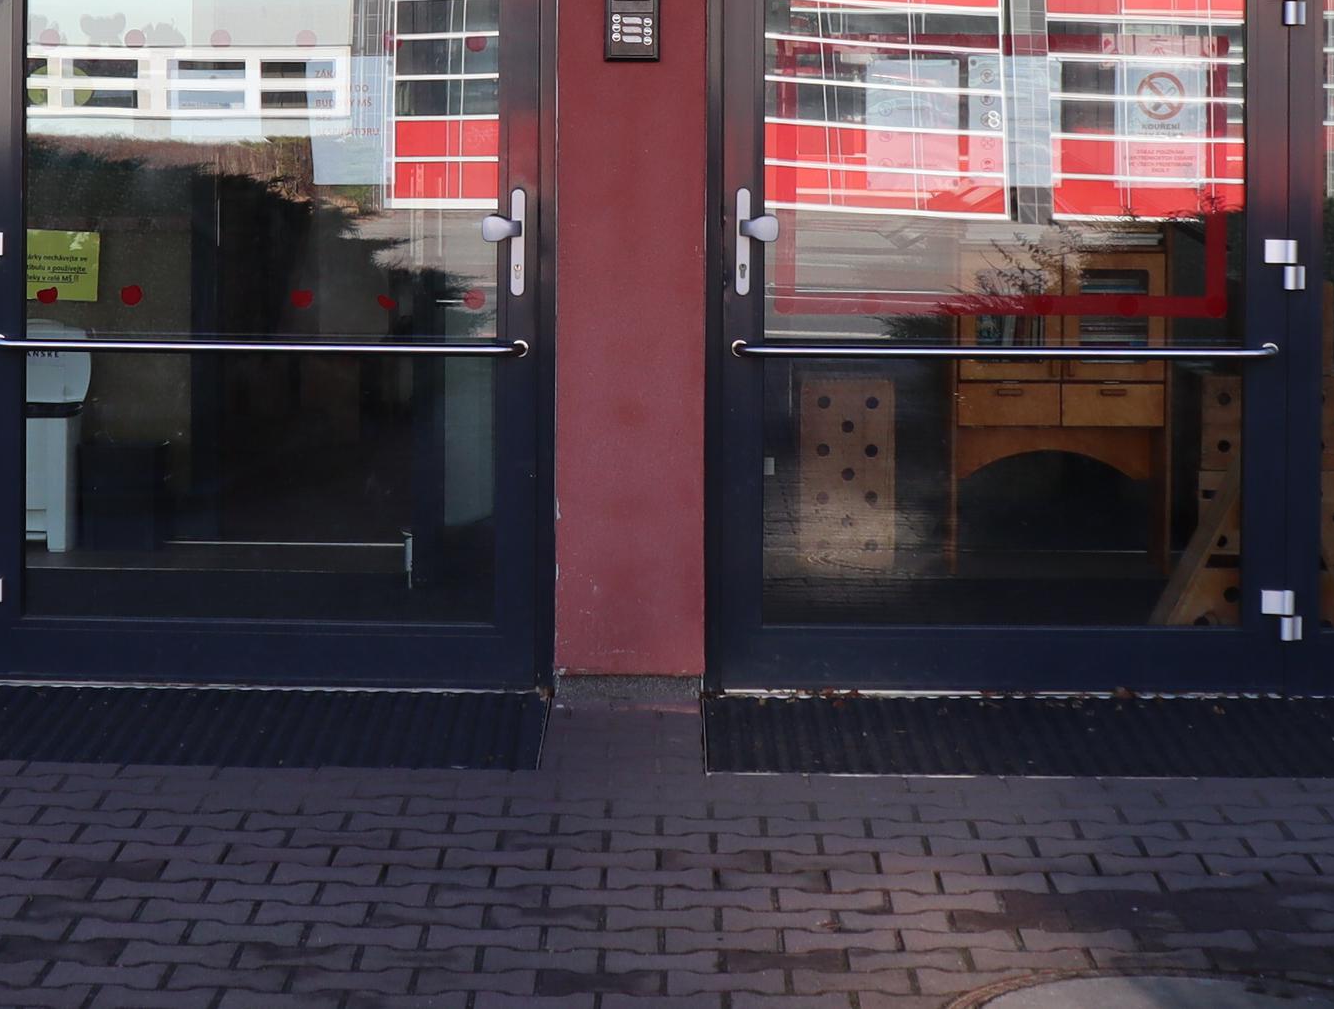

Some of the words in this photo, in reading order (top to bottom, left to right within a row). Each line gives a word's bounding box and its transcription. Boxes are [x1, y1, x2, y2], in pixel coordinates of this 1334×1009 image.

[315, 69, 336, 79] ZÁK
[315, 98, 354, 108] BUDY
[27, 254, 42, 262] árky
